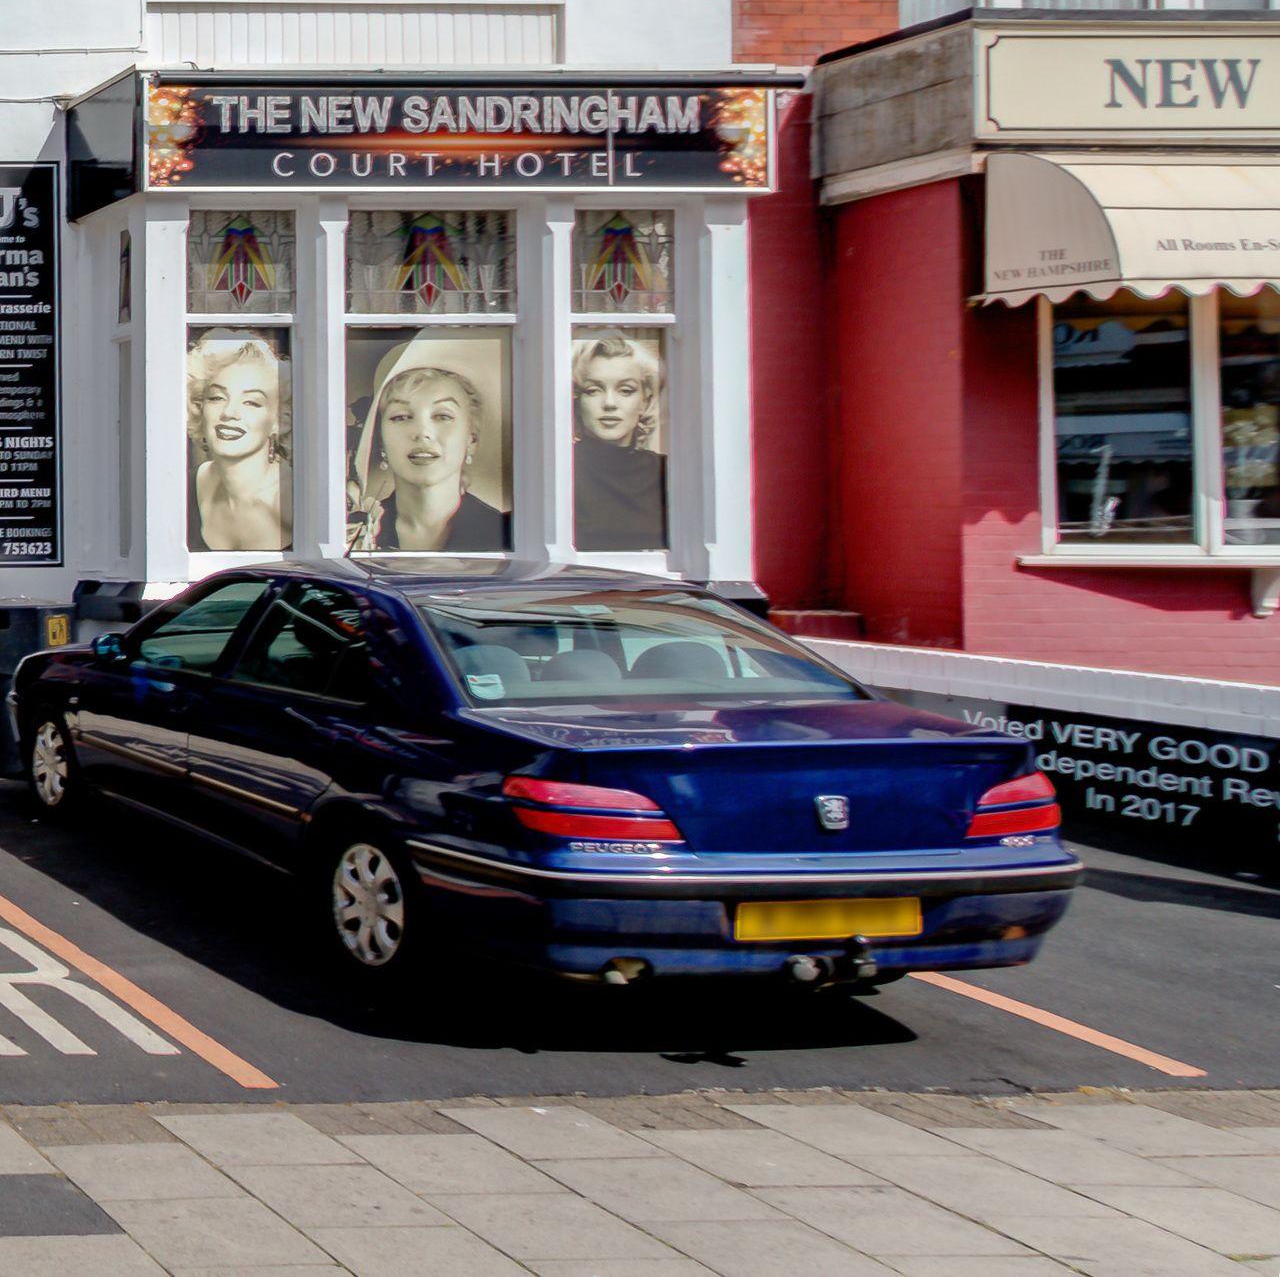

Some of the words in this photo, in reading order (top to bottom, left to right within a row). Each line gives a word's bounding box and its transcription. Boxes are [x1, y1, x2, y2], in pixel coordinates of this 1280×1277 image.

[1102, 58, 1262, 110] NEW
[211, 95, 293, 135] THE
[299, 95, 394, 135] NEW
[401, 94, 701, 135] SANDRINGHAM
[272, 152, 441, 178] COURT
[479, 152, 644, 178] HOTEL
[1155, 238, 1177, 252] All
[1182, 238, 1237, 252] Rooms
[1039, 249, 1068, 262] THE
[993, 268, 1026, 282] NEW
[1027, 258, 1113, 279] HAMPSHIRE
[15, 348, 48, 360] TWIST
[3, 436, 54, 449] NIGHTS
[13, 450, 54, 460] SUNDAY
[20, 487, 52, 498] MENU
[15, 499, 29, 509] TO
[6, 527, 53, 538] BOOKINGS
[2, 541, 53, 556] 753623
[962, 709, 1045, 741] Voted
[1051, 721, 1142, 755] VERY
[1148, 735, 1271, 774] GOOD
[1085, 787, 1117, 813] In
[1121, 794, 1202, 827] 2017
[568, 841, 663, 855] PEUGEOT
